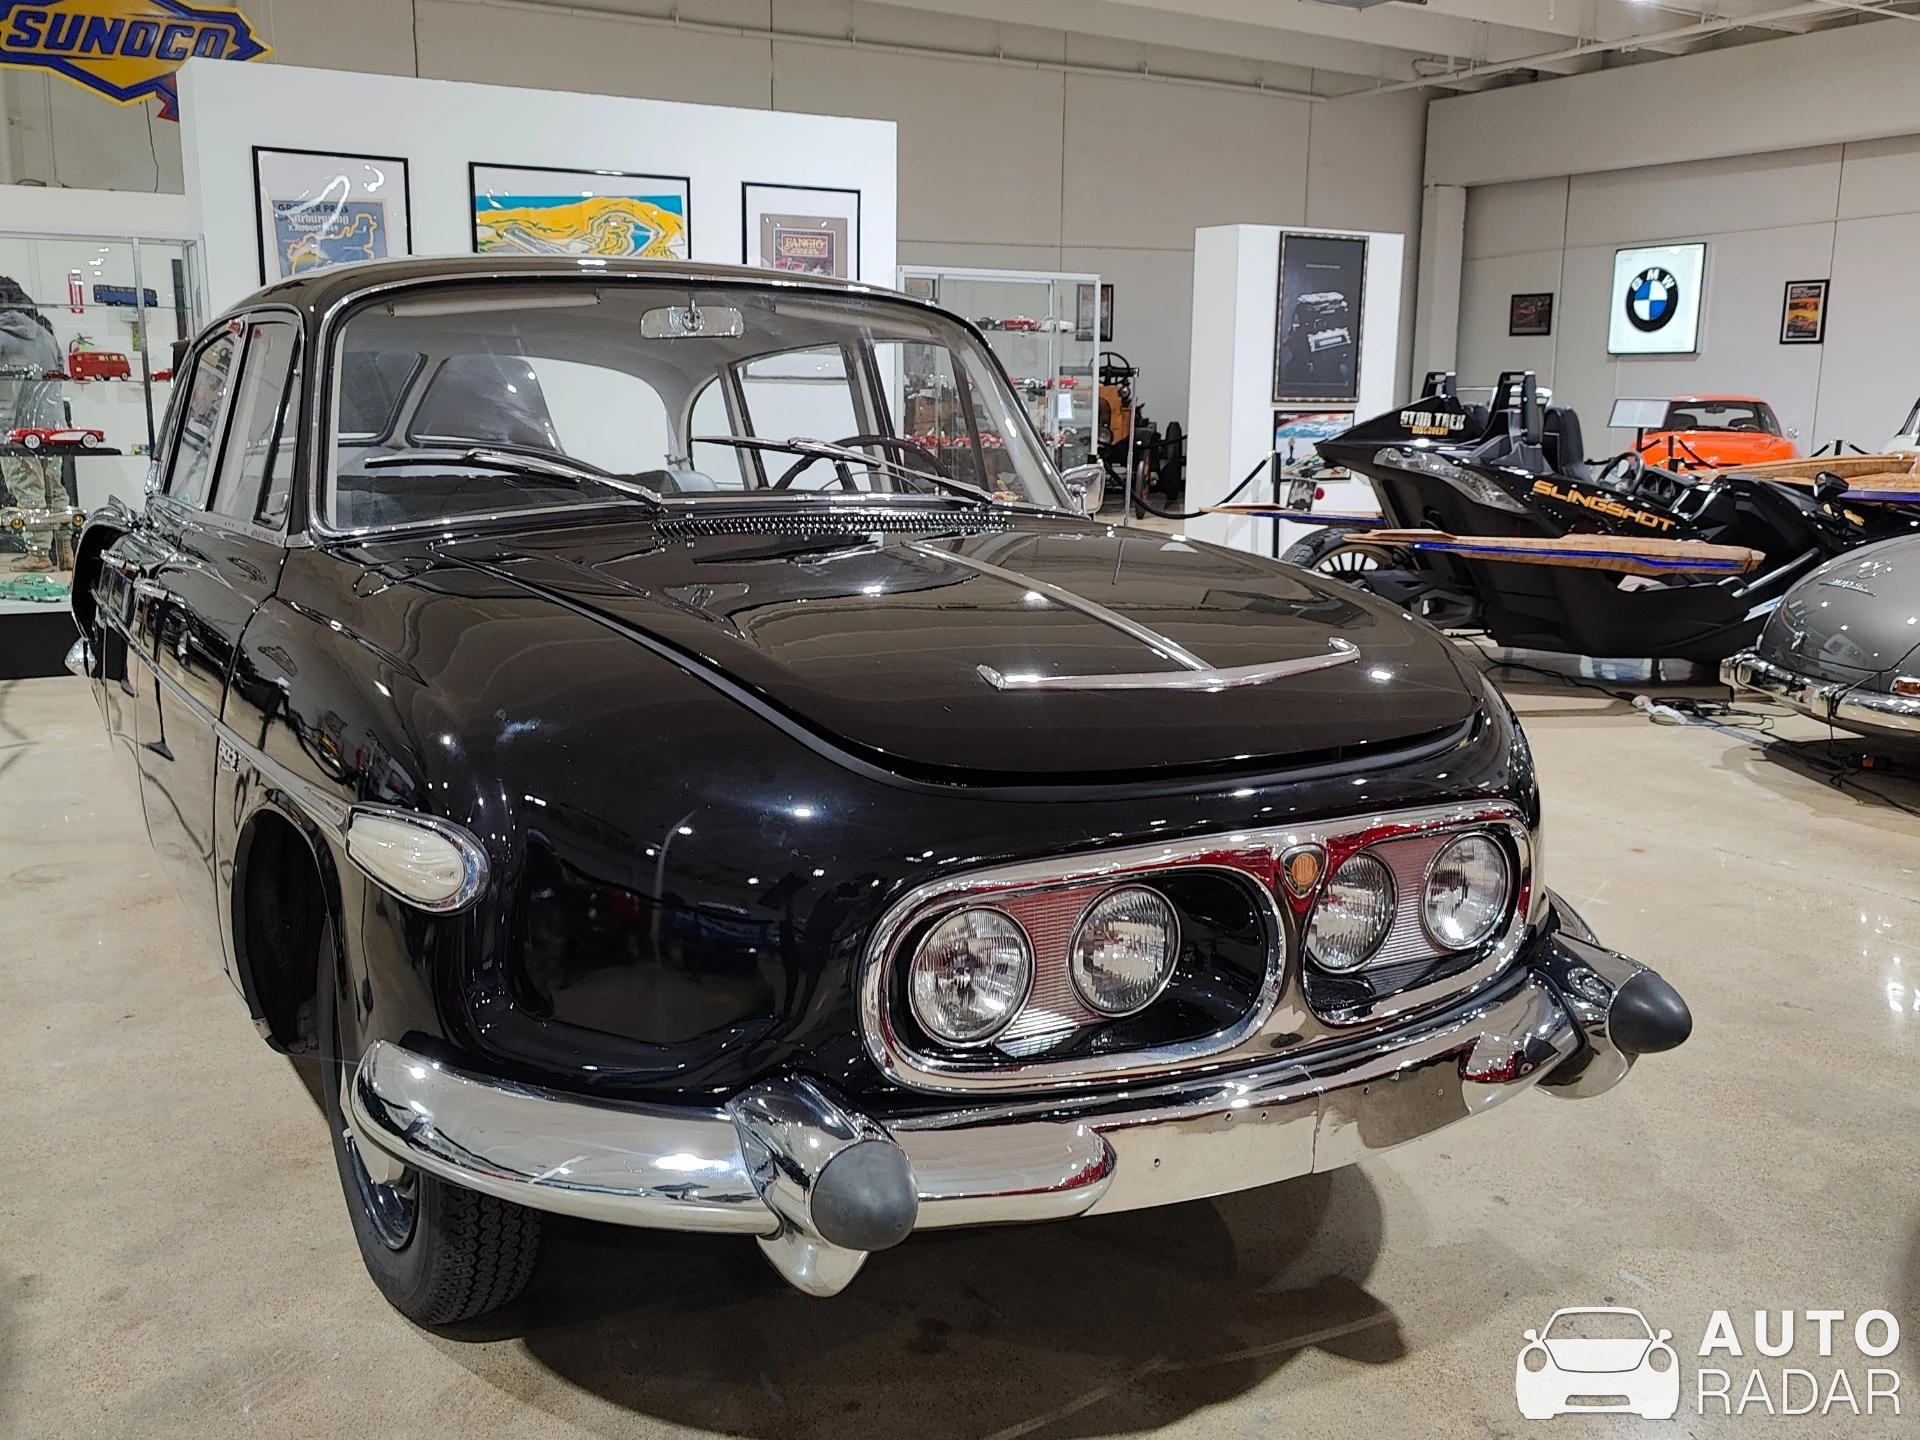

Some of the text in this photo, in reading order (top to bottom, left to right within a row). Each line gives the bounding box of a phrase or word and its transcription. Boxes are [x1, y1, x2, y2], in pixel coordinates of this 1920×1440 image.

[5, 9, 231, 60] SUNOCO
[295, 224, 322, 233] AUGUST
[785, 237, 824, 250] FANGIO
[1631, 268, 1676, 291] BMW
[1400, 411, 1466, 431] STAR TREK
[1411, 426, 1449, 436] DISCOVERY
[1532, 479, 1676, 531] SLINGSHOT
